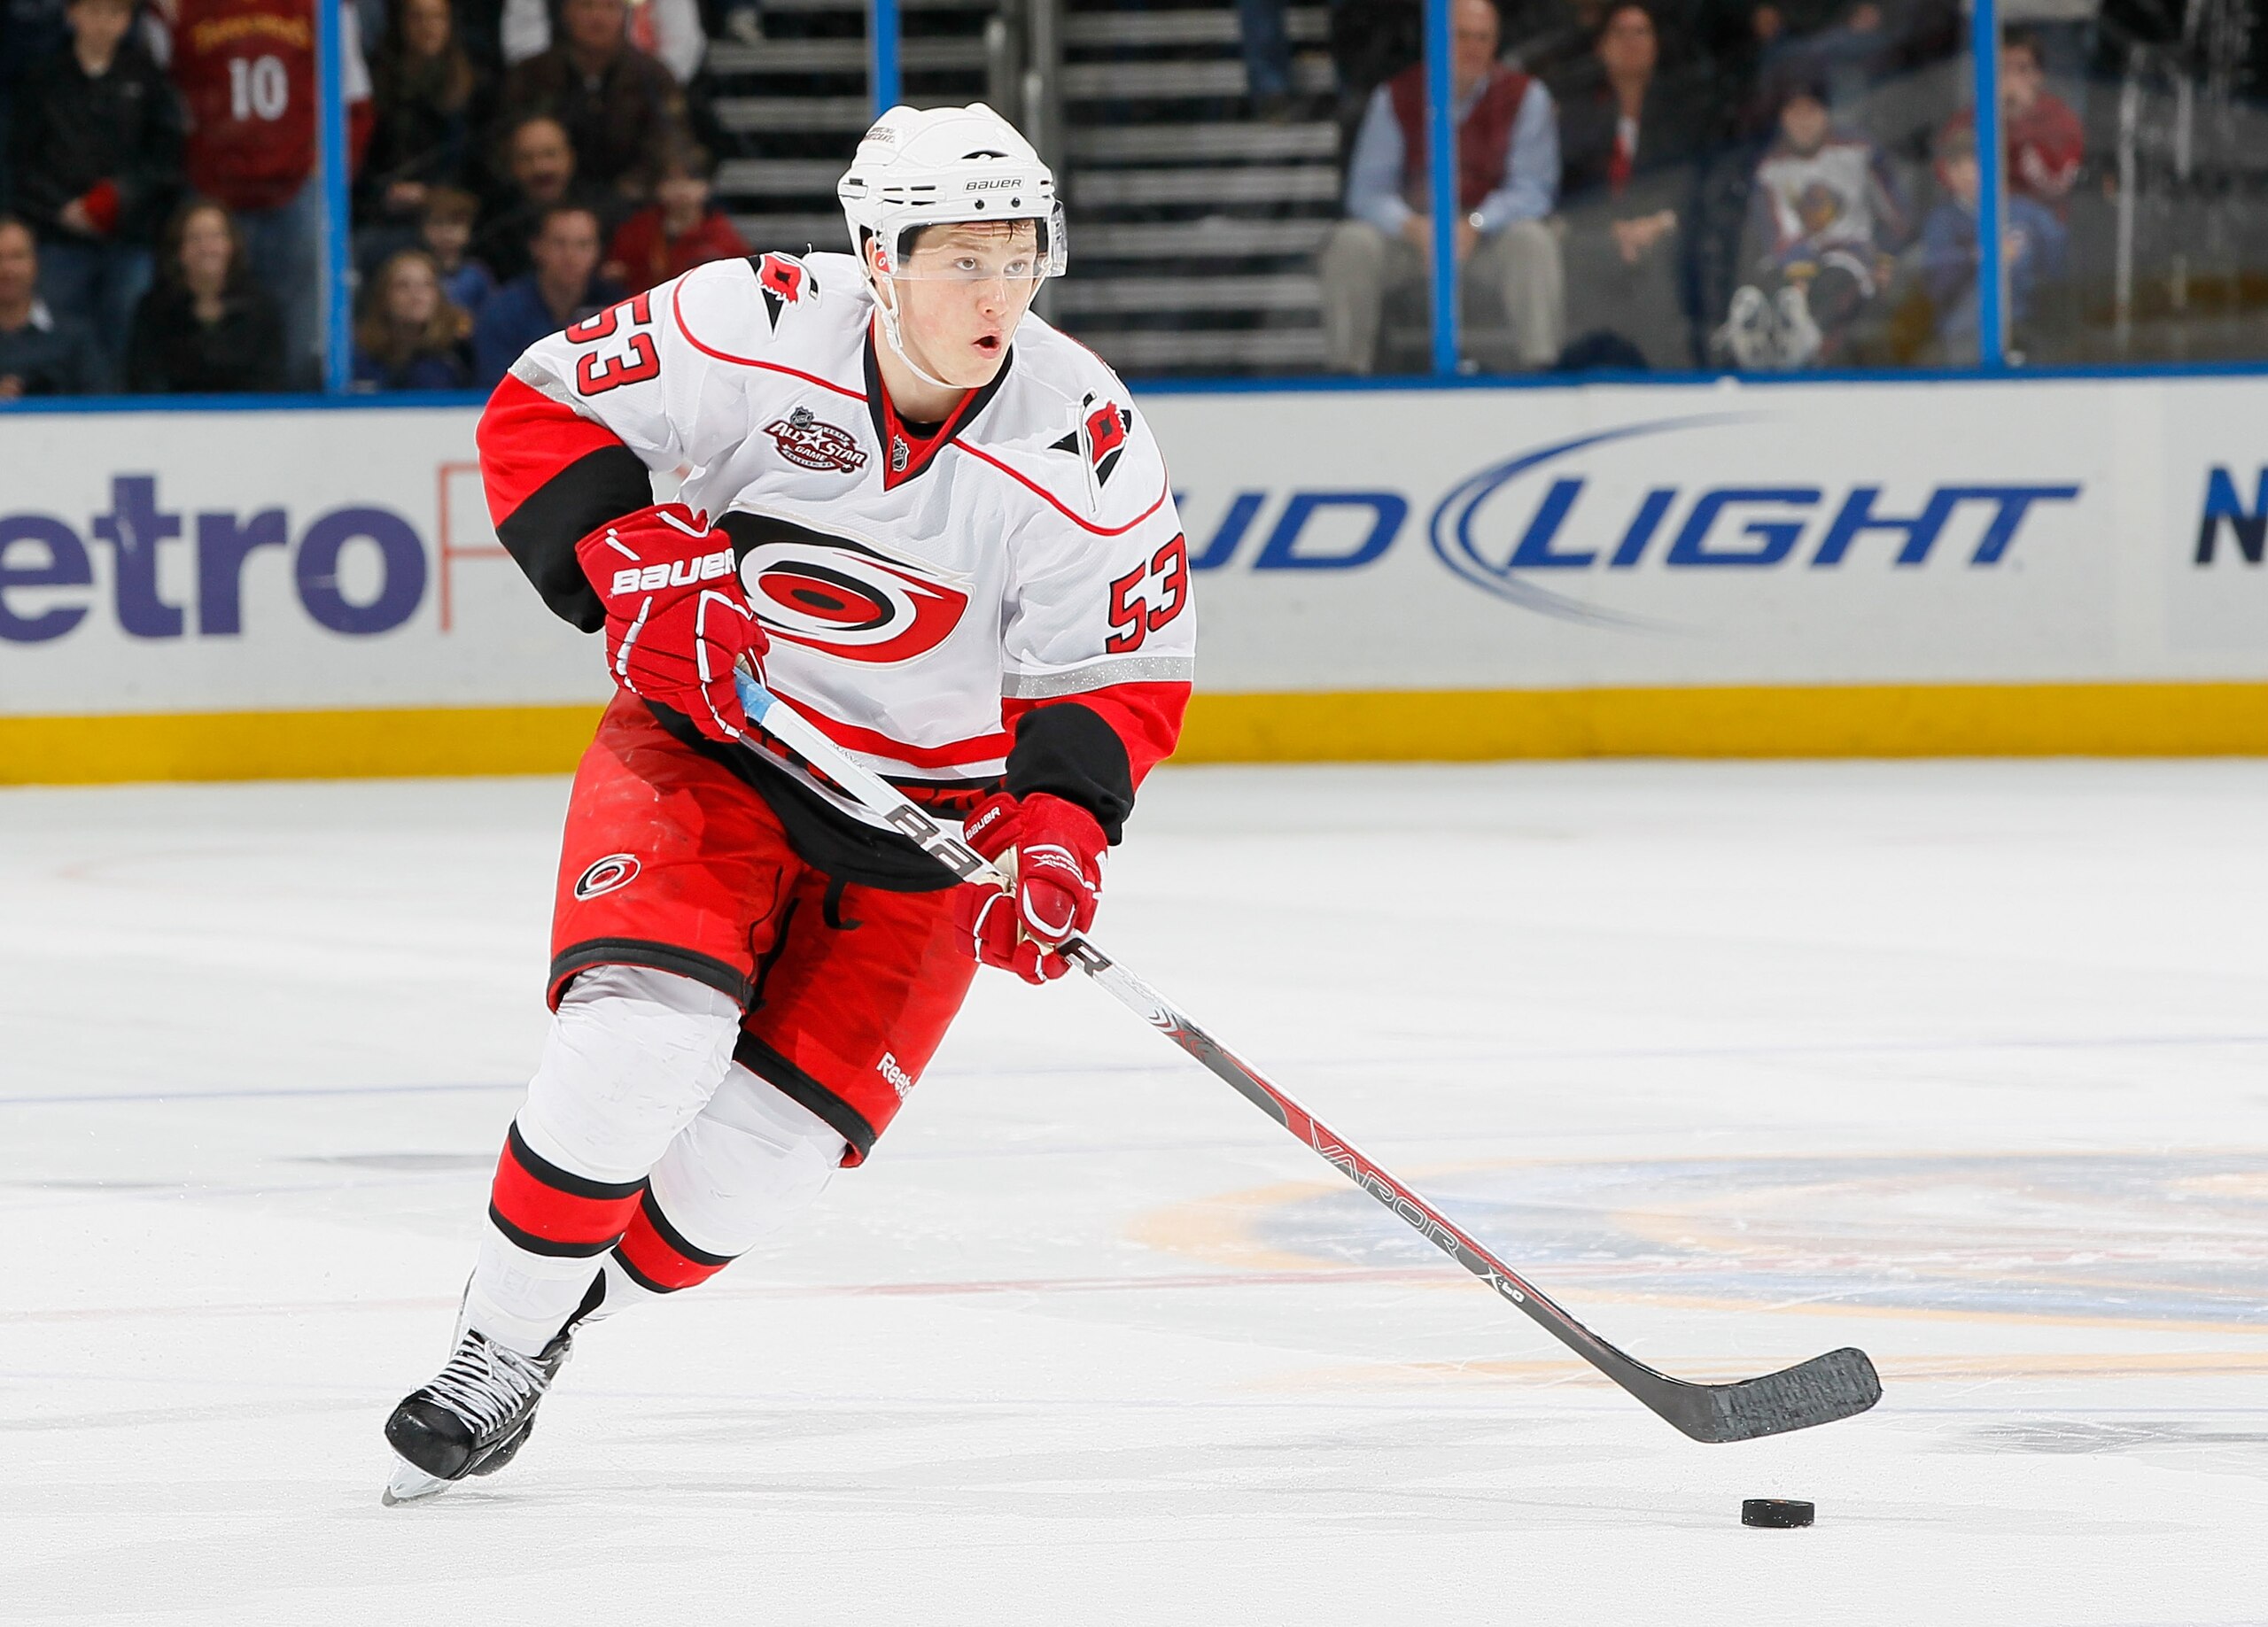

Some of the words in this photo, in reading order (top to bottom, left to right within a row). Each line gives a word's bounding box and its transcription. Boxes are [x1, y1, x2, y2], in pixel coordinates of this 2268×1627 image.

[227, 53, 290, 122] 10
[965, 178, 1022, 191] BAUER
[565, 290, 661, 397] 53
[768, 422, 801, 442] ALL
[819, 443, 866, 465] STAR
[794, 445, 828, 461] GAME
[1505, 474, 2081, 570] LIGHT
[610, 546, 738, 596] BAUER
[1104, 531, 1189, 655] 53
[965, 805, 1001, 841] BAUER
